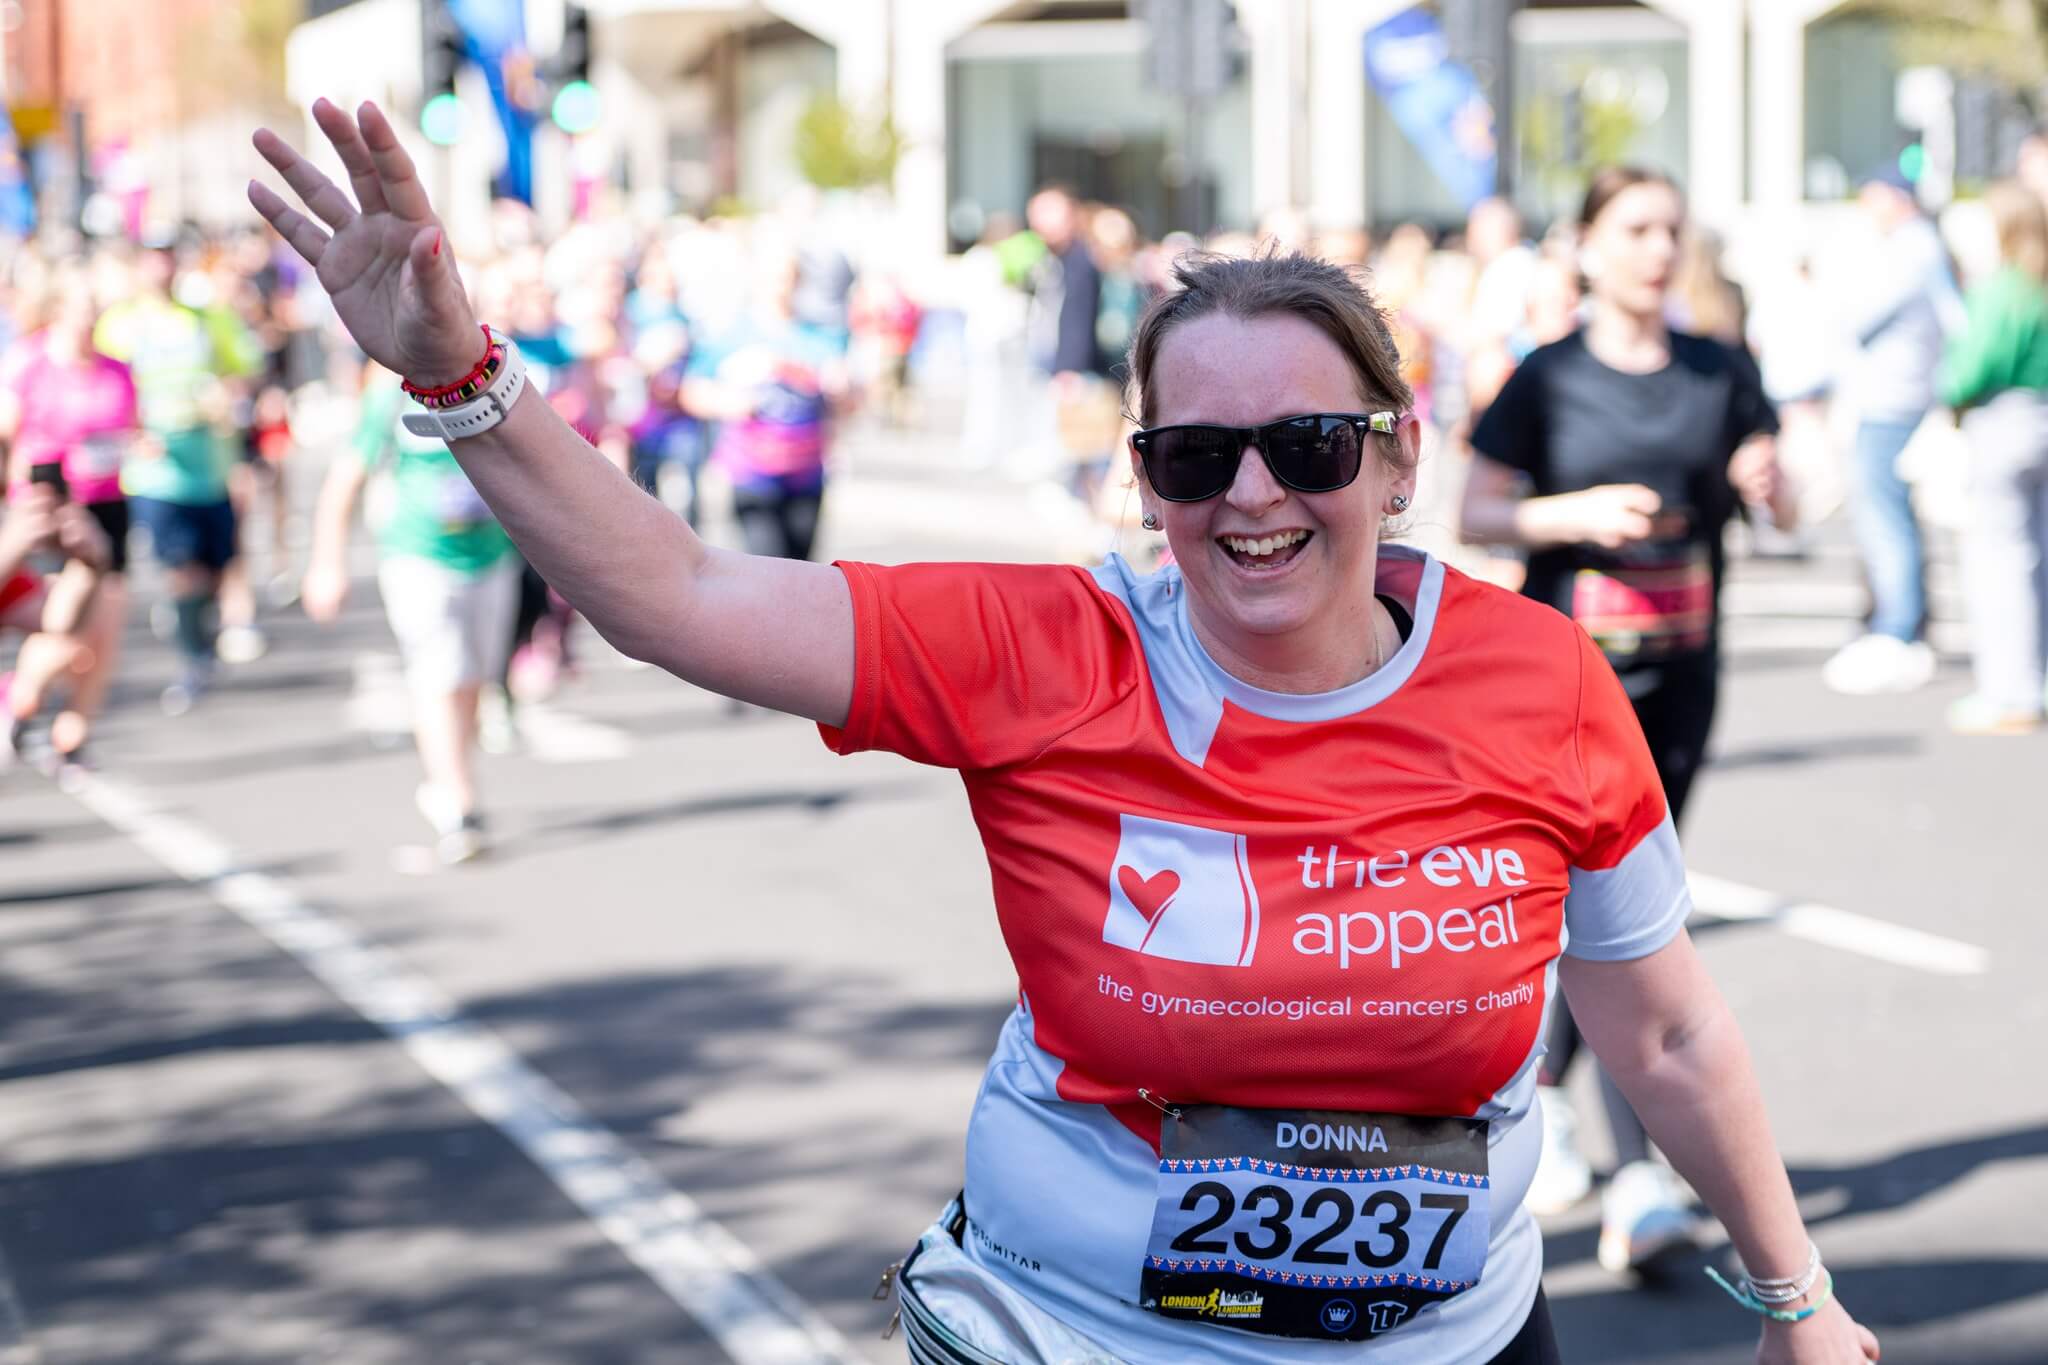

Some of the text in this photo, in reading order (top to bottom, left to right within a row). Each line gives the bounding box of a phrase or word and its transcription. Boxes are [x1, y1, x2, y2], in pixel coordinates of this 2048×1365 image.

[1297, 845, 1528, 889] the eve
[1292, 892, 1519, 969] appeal
[1098, 973, 1534, 1020] the gynaecological cancers charity
[1276, 1121, 1388, 1153] DONNA
[1170, 1181, 1470, 1270] 23237
[1161, 1295, 1207, 1308] LONDON
